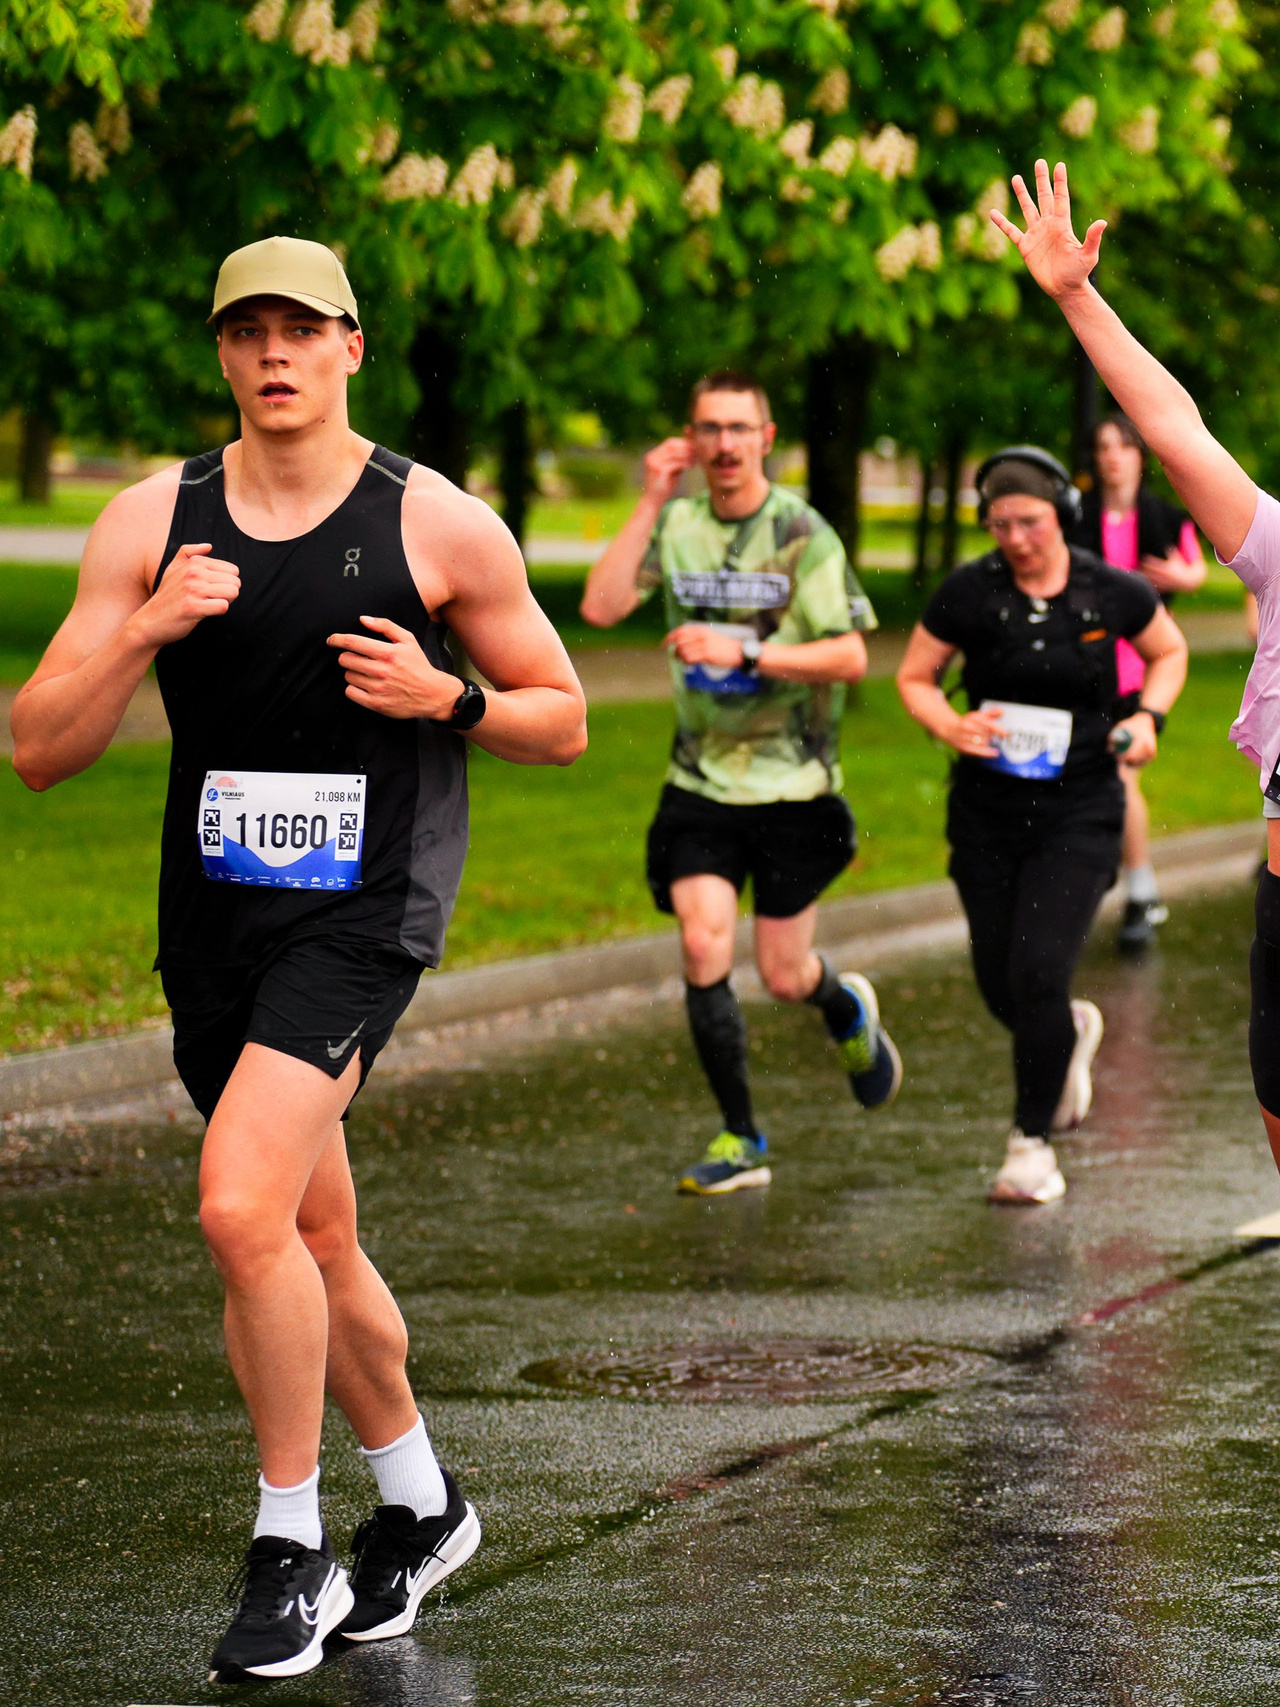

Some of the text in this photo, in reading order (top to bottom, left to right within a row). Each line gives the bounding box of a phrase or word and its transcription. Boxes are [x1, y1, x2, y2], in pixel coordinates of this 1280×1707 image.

[315, 791, 361, 803] 21,098 KM
[236, 813, 328, 849] 11660
